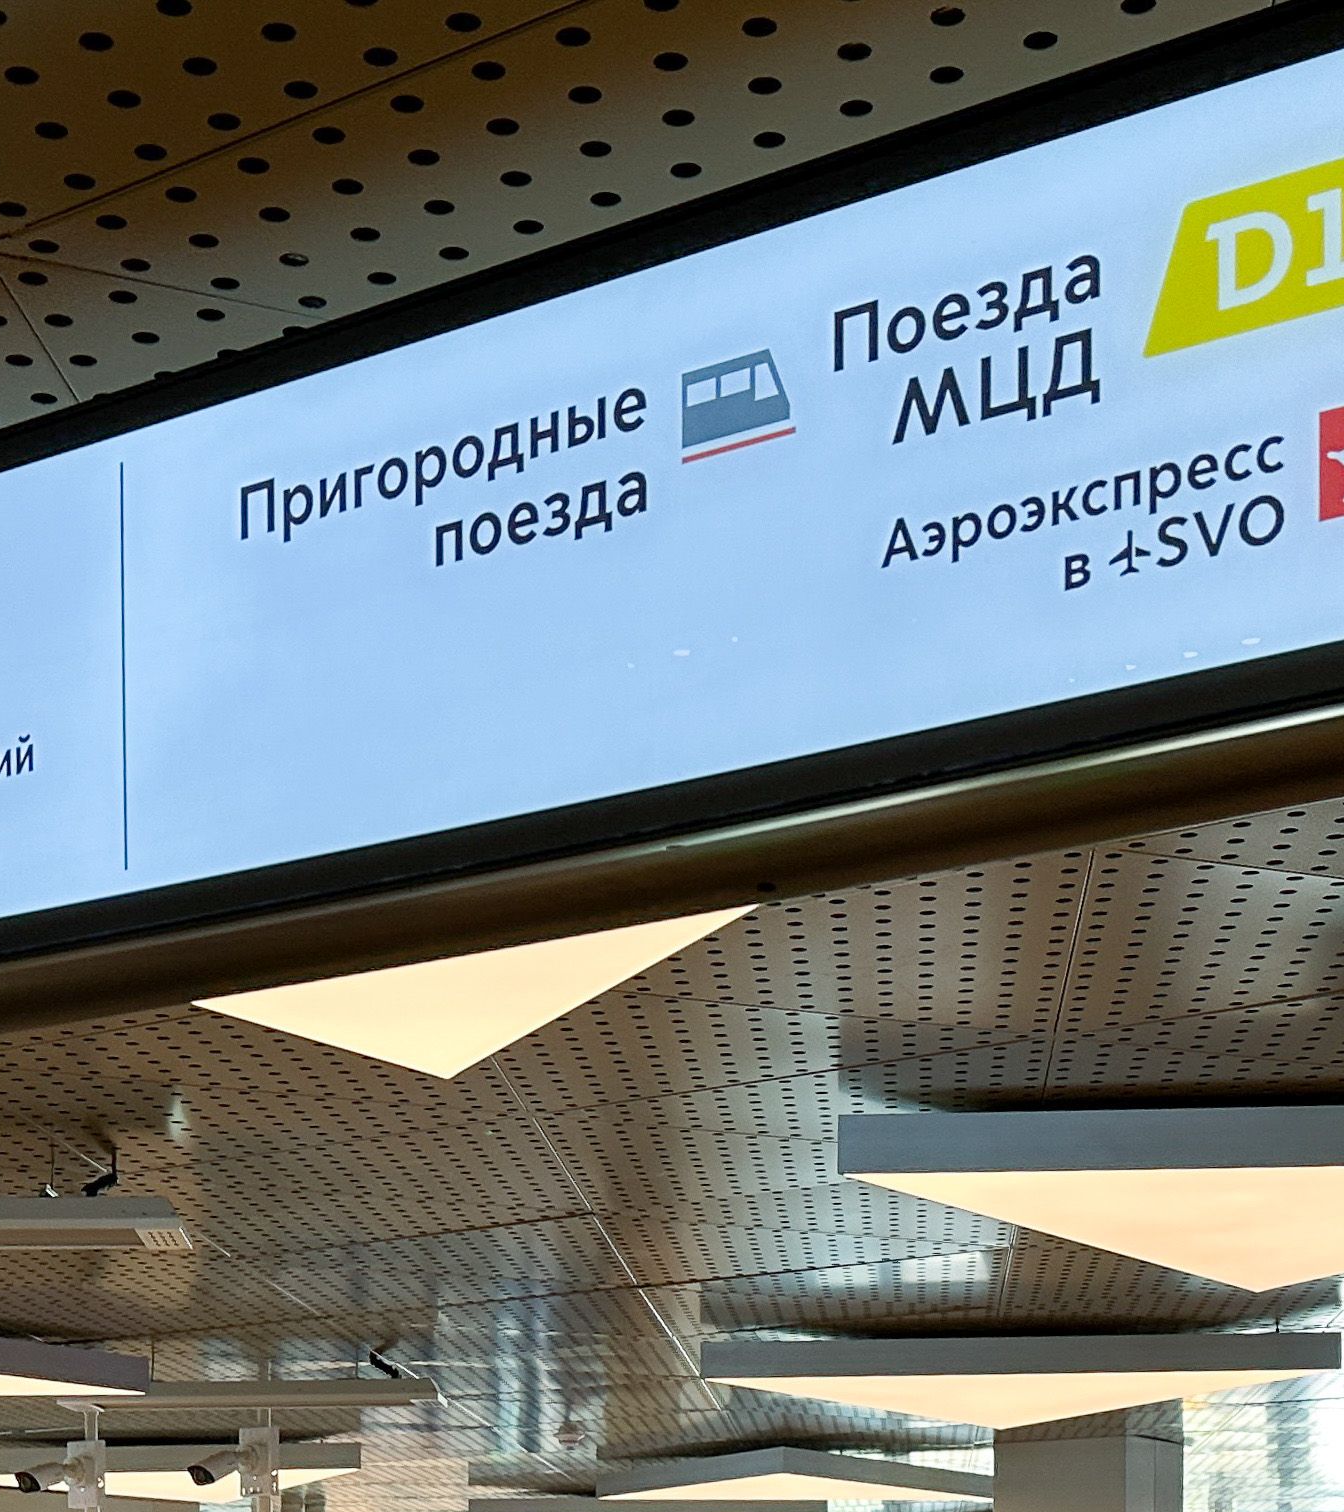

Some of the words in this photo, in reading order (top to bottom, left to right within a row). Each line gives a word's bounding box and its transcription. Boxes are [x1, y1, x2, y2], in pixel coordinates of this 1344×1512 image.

[834, 255, 1101, 372] Поезда
[892, 331, 1101, 445] МЦД
[241, 388, 647, 540] Пригородные
[436, 472, 648, 566] поезда
[881, 436, 1284, 568] Аэроэкспресс
[1065, 554, 1090, 591] в
[1157, 495, 1284, 567] SVO
